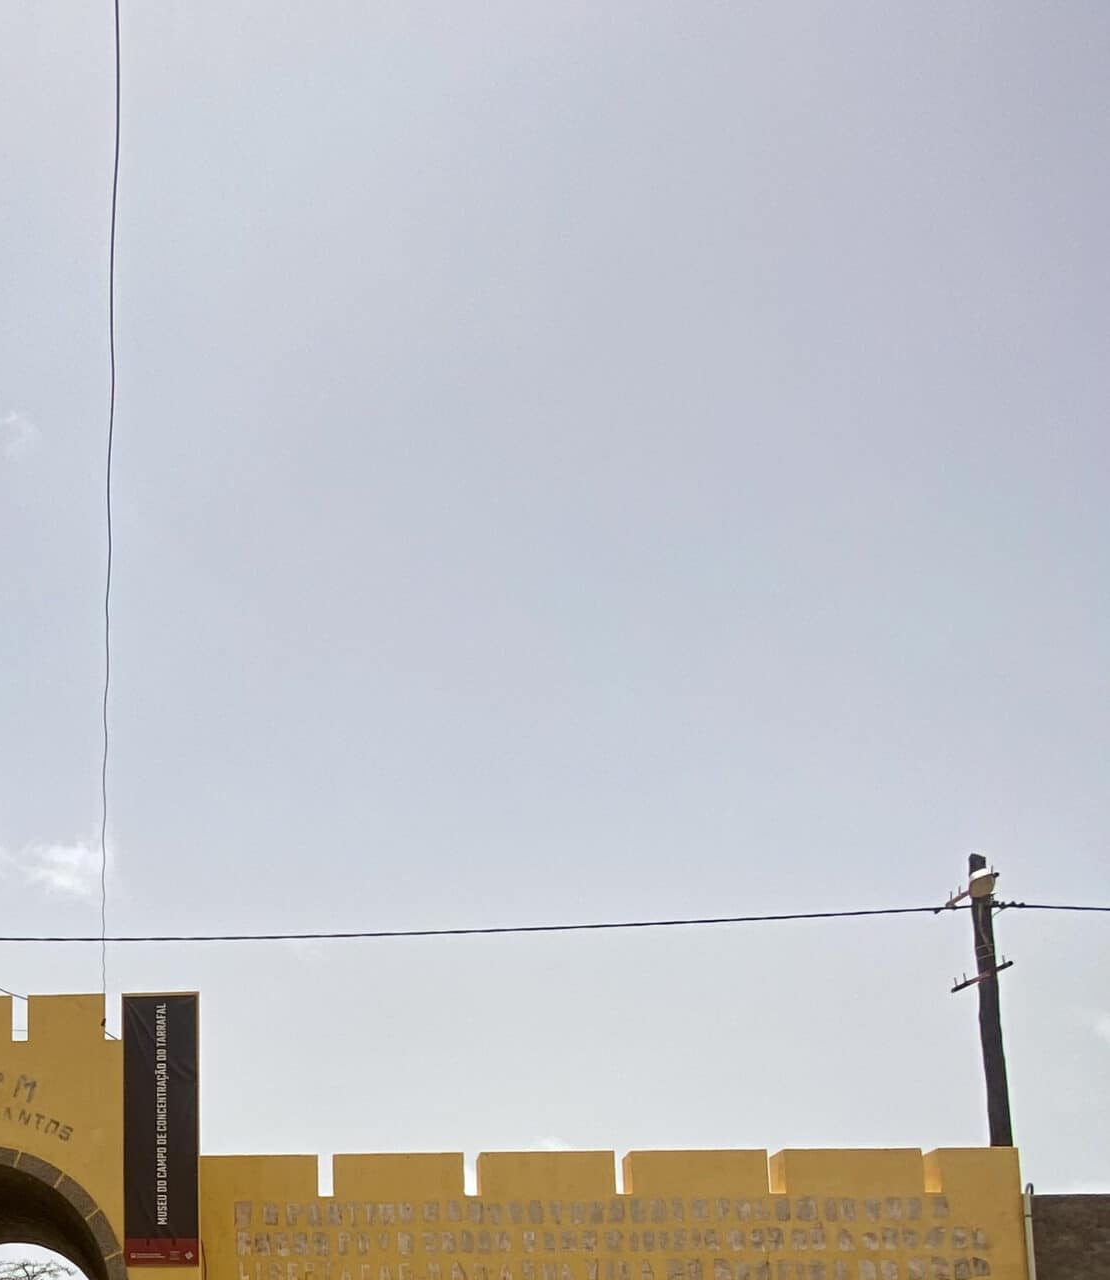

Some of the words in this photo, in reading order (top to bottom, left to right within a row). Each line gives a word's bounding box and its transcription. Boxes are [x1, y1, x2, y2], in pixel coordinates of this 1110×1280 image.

[156, 1002, 168, 1047] TARRAFAL
[156, 1048, 168, 1061] DO
[155, 1062, 169, 1132] CONCENTRAÇÃO
[156, 1133, 168, 1145] DE
[156, 1147, 168, 1178] CAMPO
[156, 1179, 168, 1193] DO
[156, 1194, 168, 1225] MUSEU
